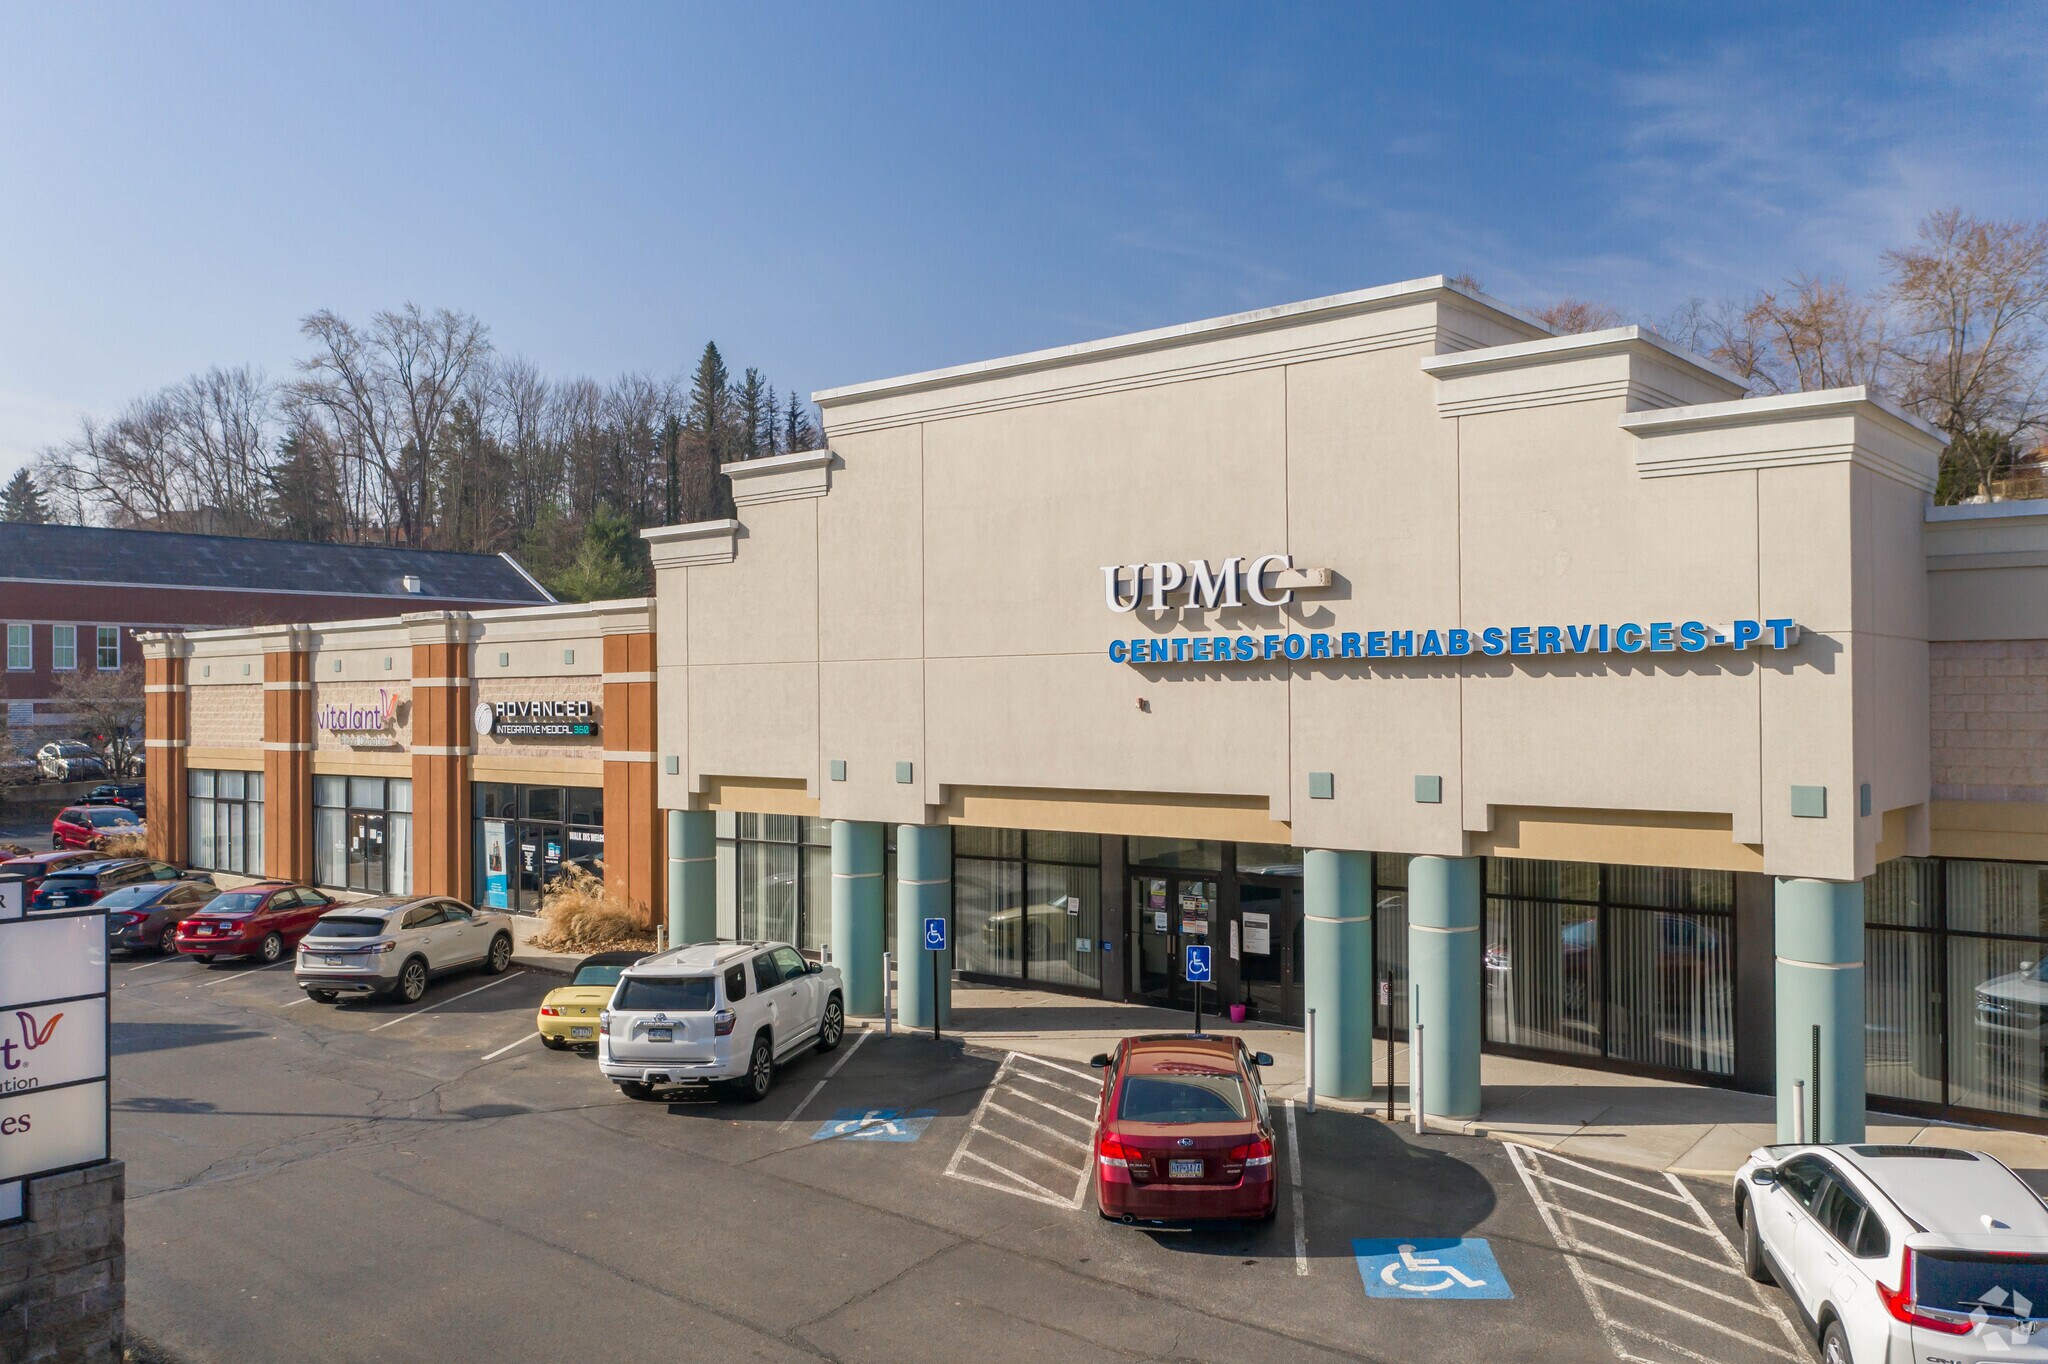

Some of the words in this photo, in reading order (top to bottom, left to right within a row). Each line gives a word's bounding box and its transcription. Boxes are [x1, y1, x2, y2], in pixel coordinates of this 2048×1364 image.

[1100, 555, 1294, 613] UPMC
[1108, 635, 1255, 663] CENTERS
[1263, 633, 1335, 660] FOR
[1341, 629, 1473, 657] REHAB
[317, 703, 382, 730] vitalant
[496, 701, 589, 717] ADVANCED
[497, 725, 540, 734] INTEGRATIVE
[541, 725, 573, 734] MEDICAL
[573, 725, 590, 734] 360
[359, 736, 390, 745] Donation
